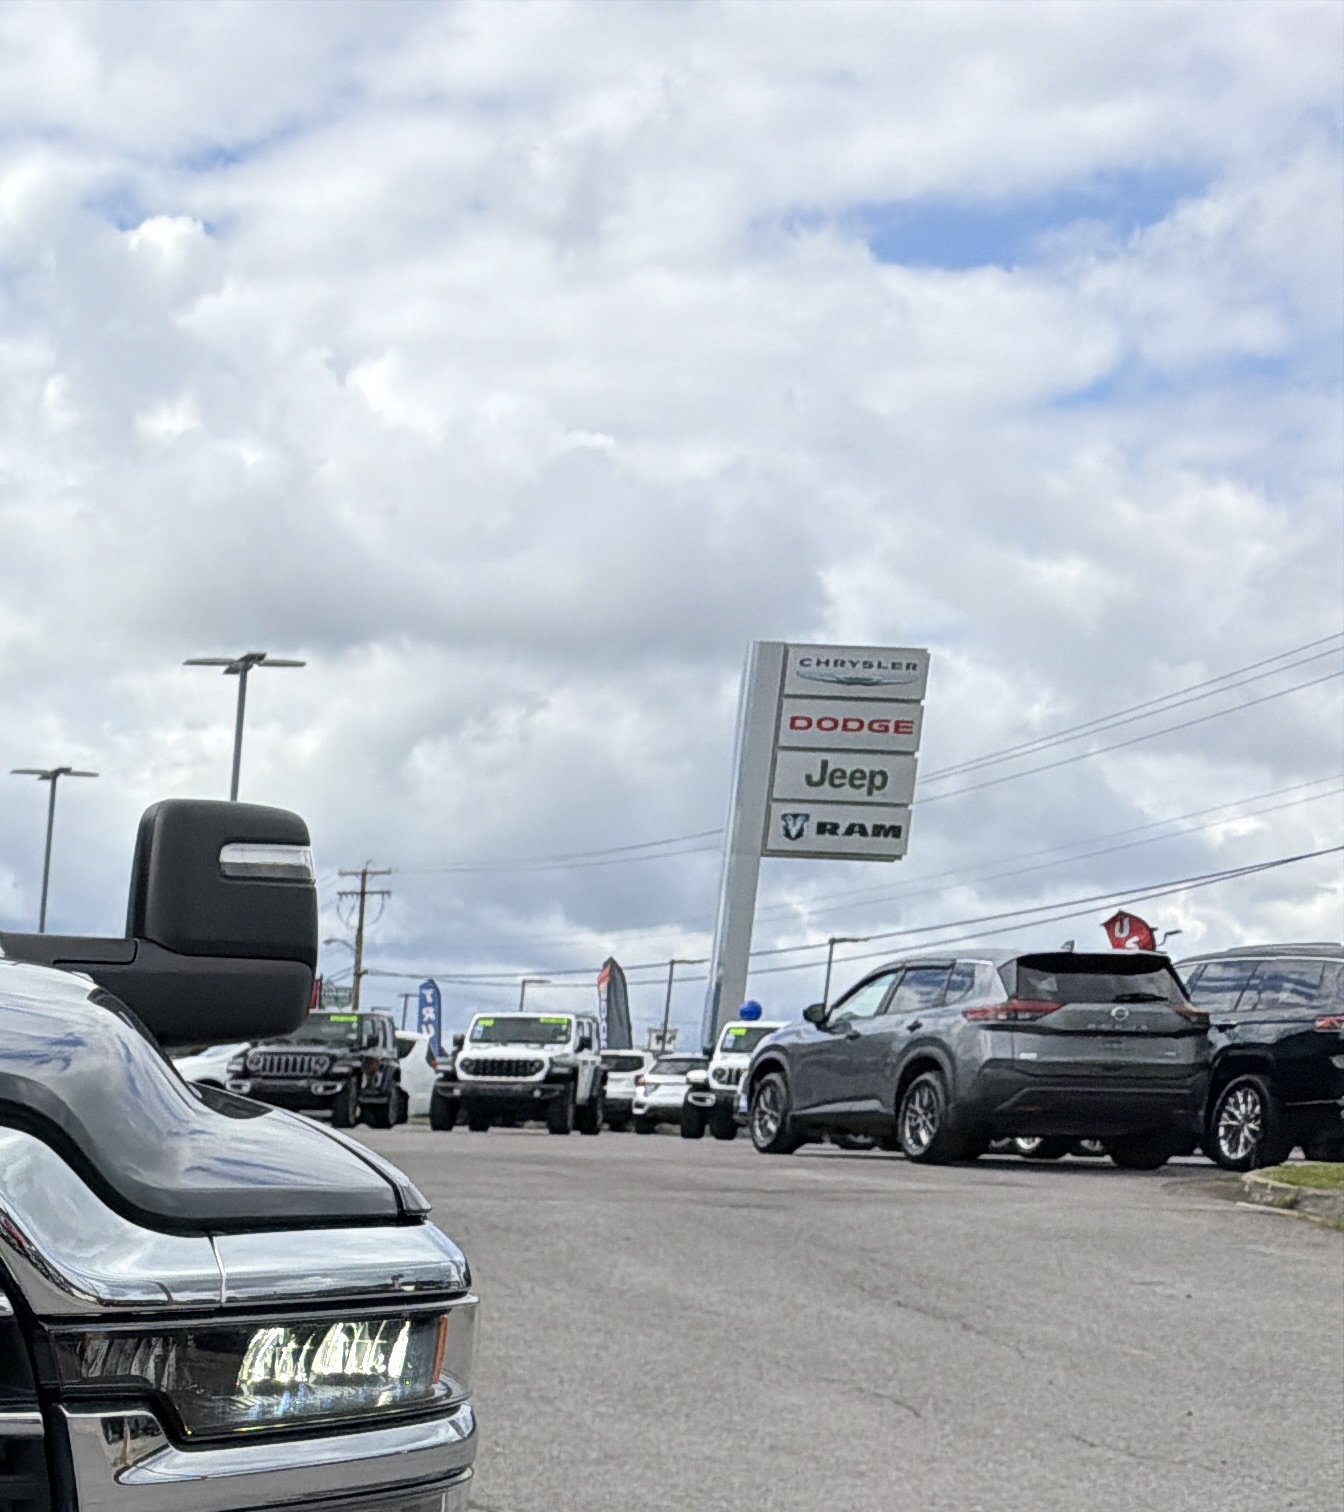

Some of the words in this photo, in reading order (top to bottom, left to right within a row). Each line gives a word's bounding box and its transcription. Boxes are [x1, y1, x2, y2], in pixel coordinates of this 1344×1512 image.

[799, 657, 918, 671] CHRYSLER
[789, 716, 914, 735] DODGE
[805, 759, 888, 796] Jeep
[816, 821, 902, 839] RAM
